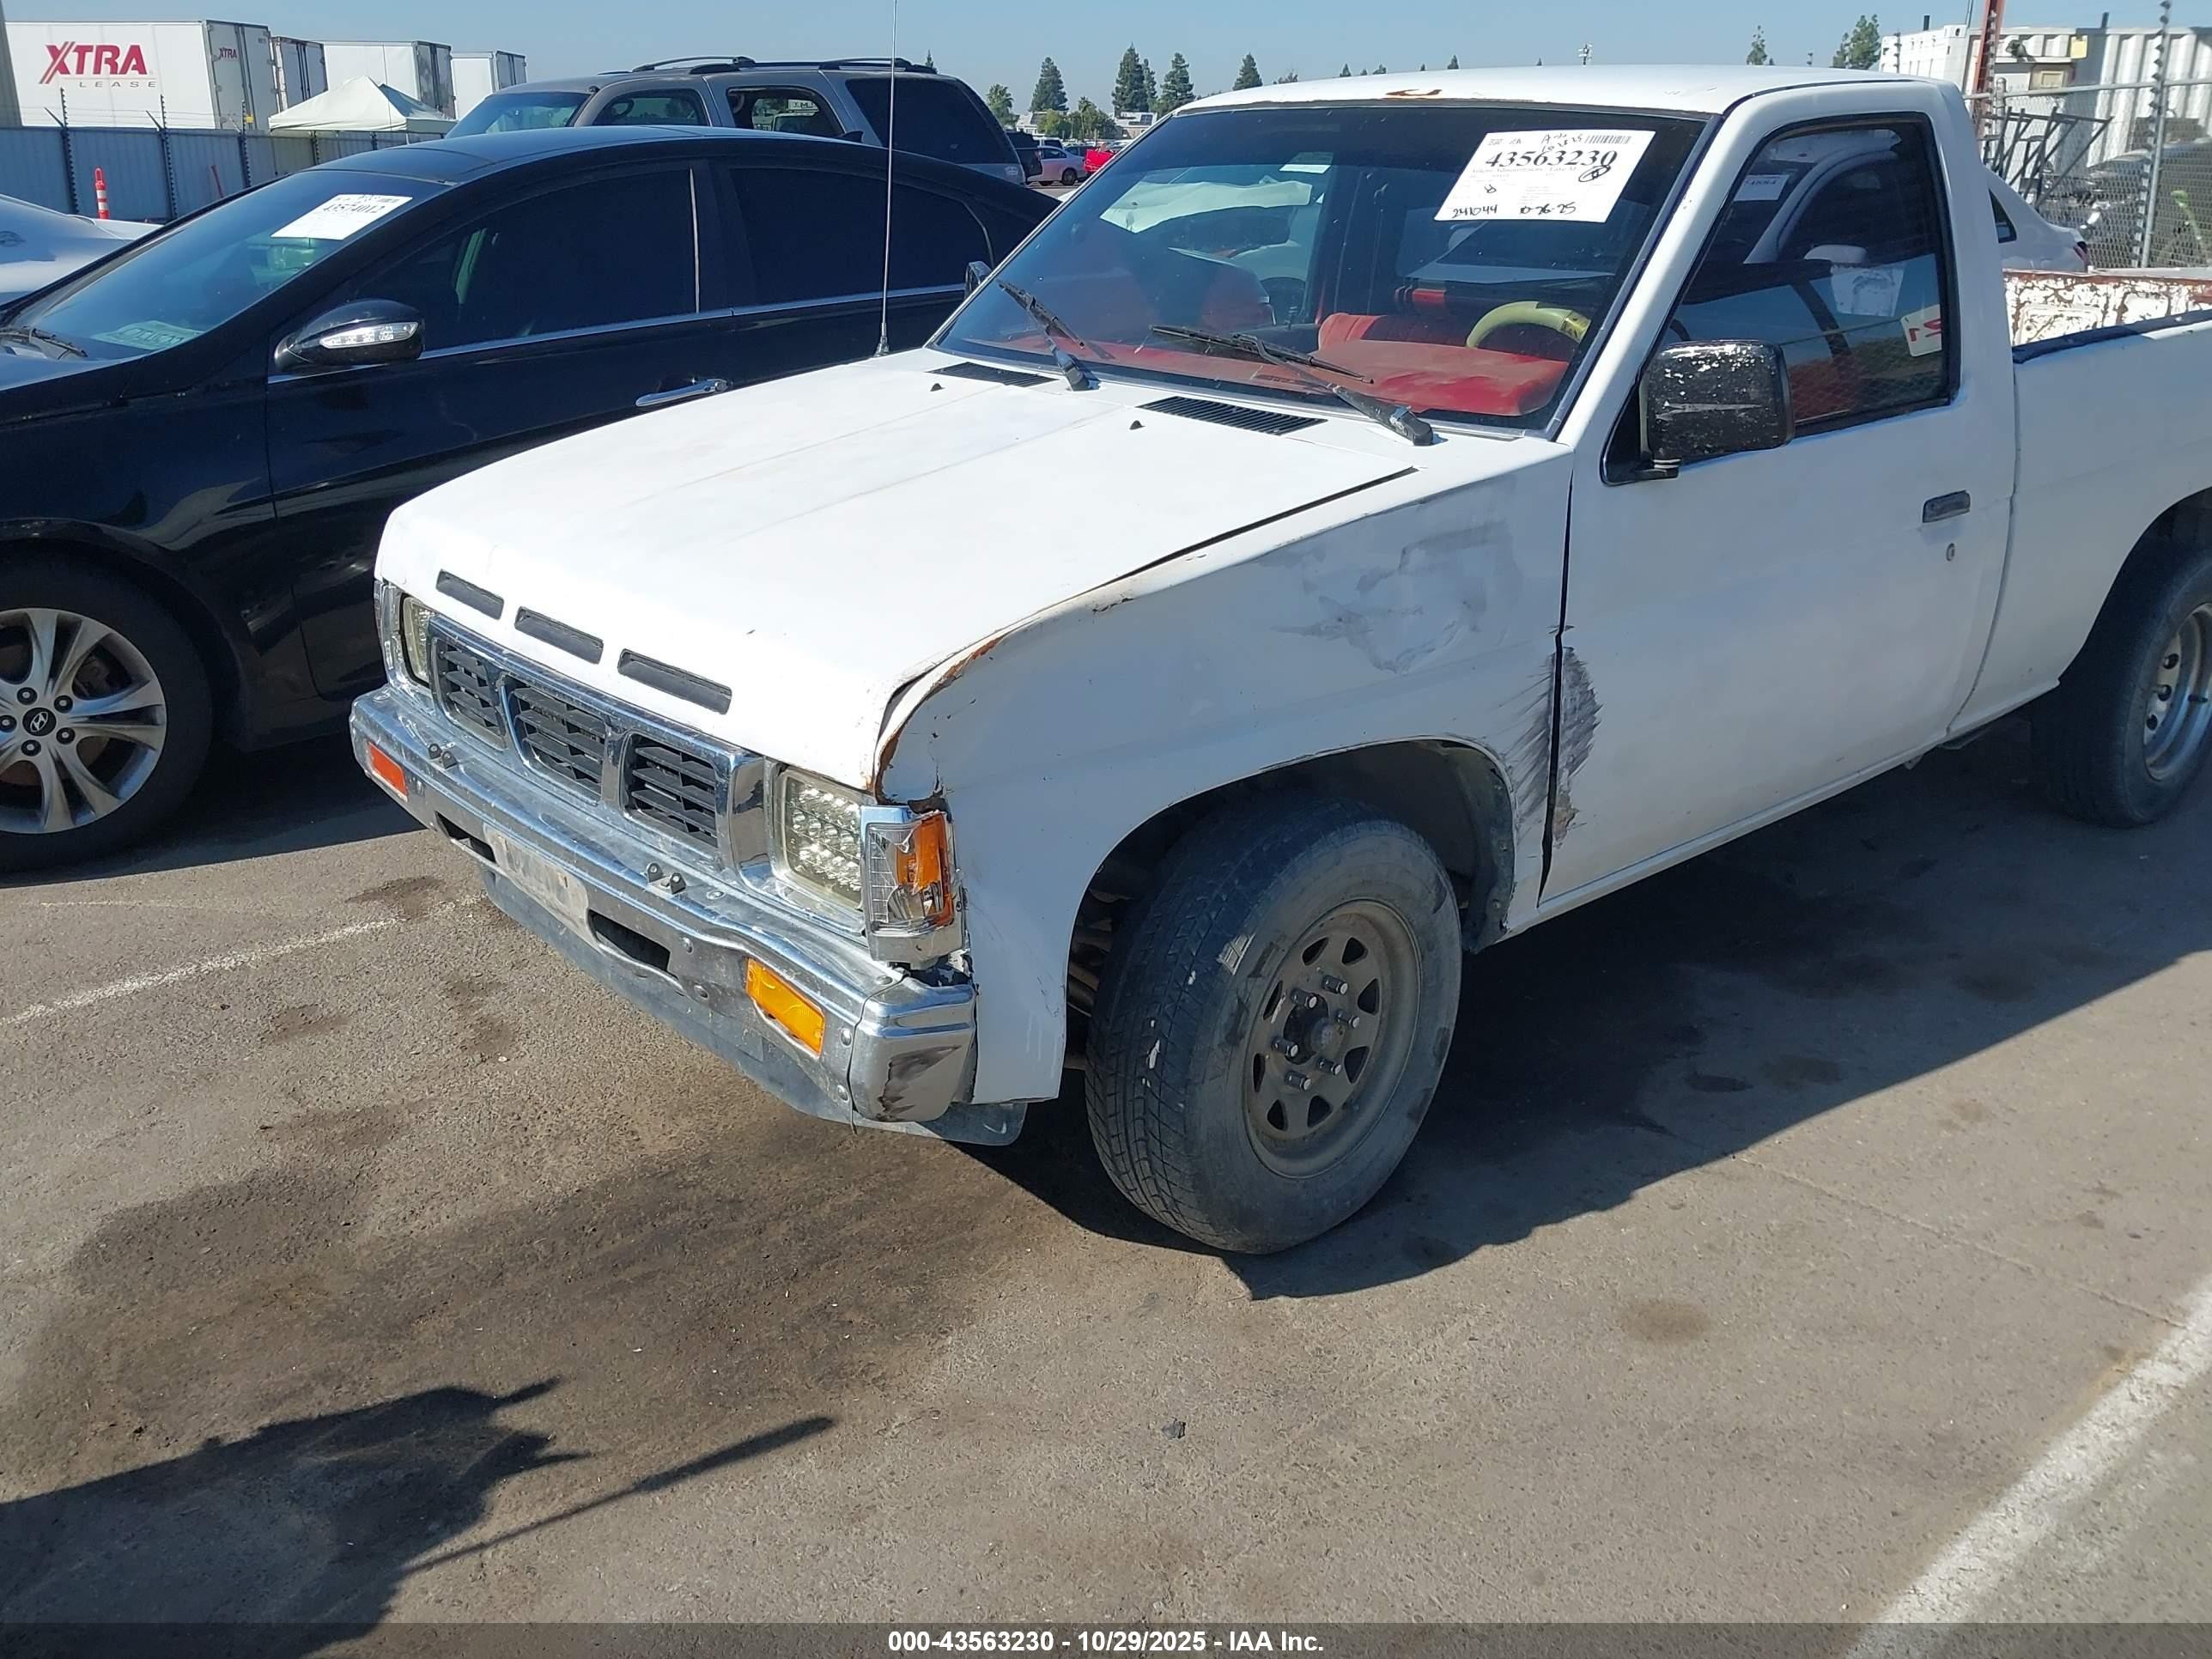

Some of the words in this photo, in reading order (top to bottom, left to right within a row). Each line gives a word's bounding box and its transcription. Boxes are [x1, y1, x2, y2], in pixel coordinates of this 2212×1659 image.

[219, 47, 238, 59] XTRA
[39, 41, 148, 84] XTRA
[1485, 149, 1618, 167] 43563230
